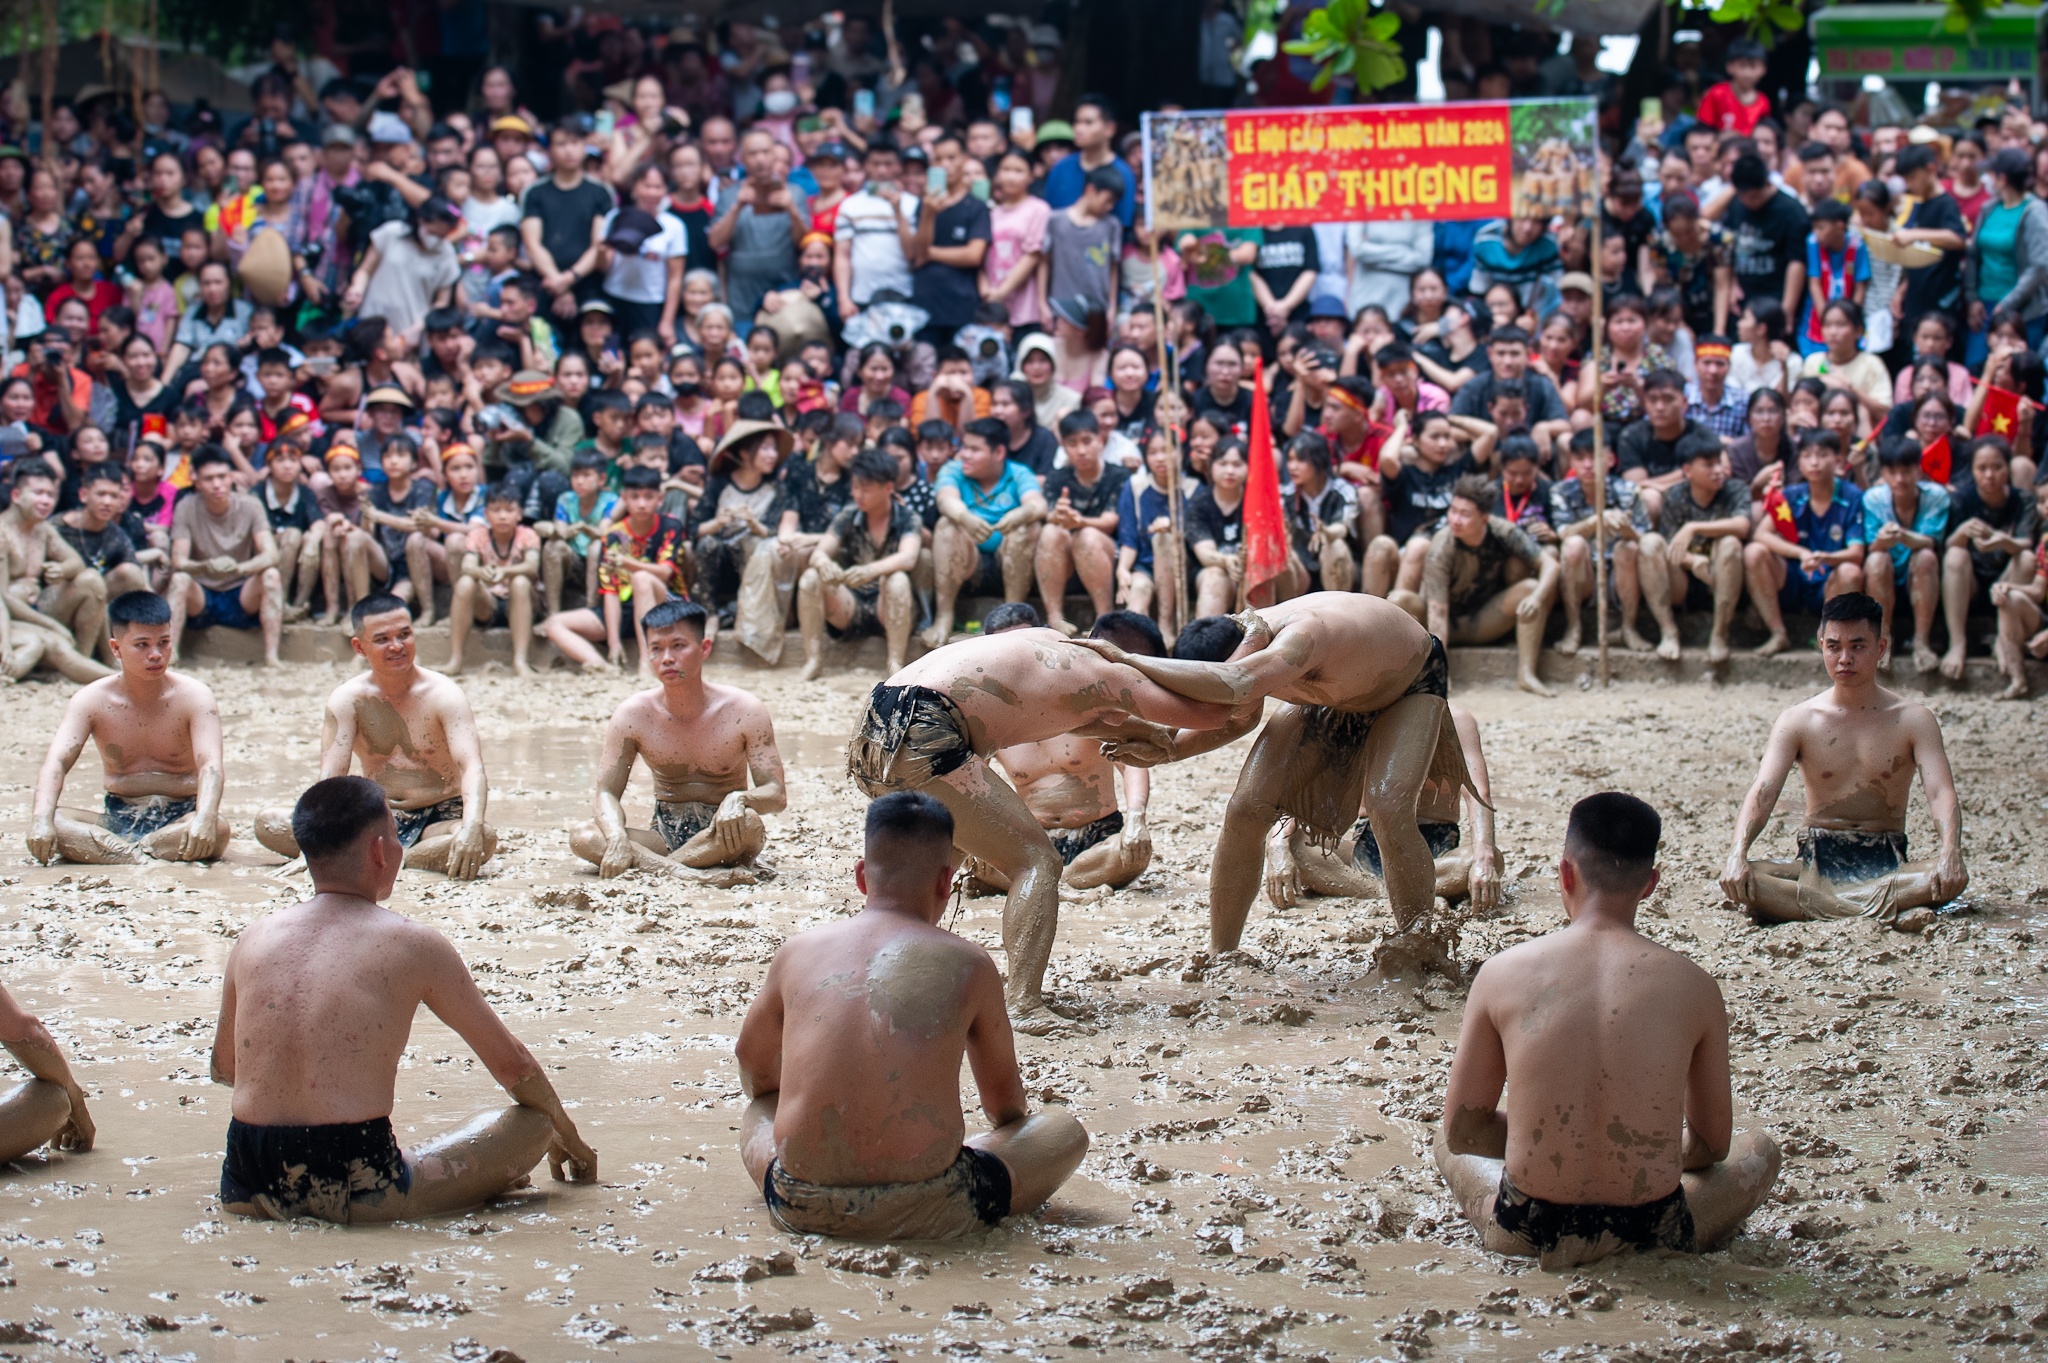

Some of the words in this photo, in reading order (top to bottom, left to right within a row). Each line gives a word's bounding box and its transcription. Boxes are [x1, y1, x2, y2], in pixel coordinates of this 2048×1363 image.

[1233, 120, 1255, 154] LỄ
[1376, 118, 1422, 149] LÀNG
[1462, 119, 1505, 147] 2024
[1242, 163, 1327, 210] GIÁP
[1338, 161, 1498, 213] THƯỢNG
